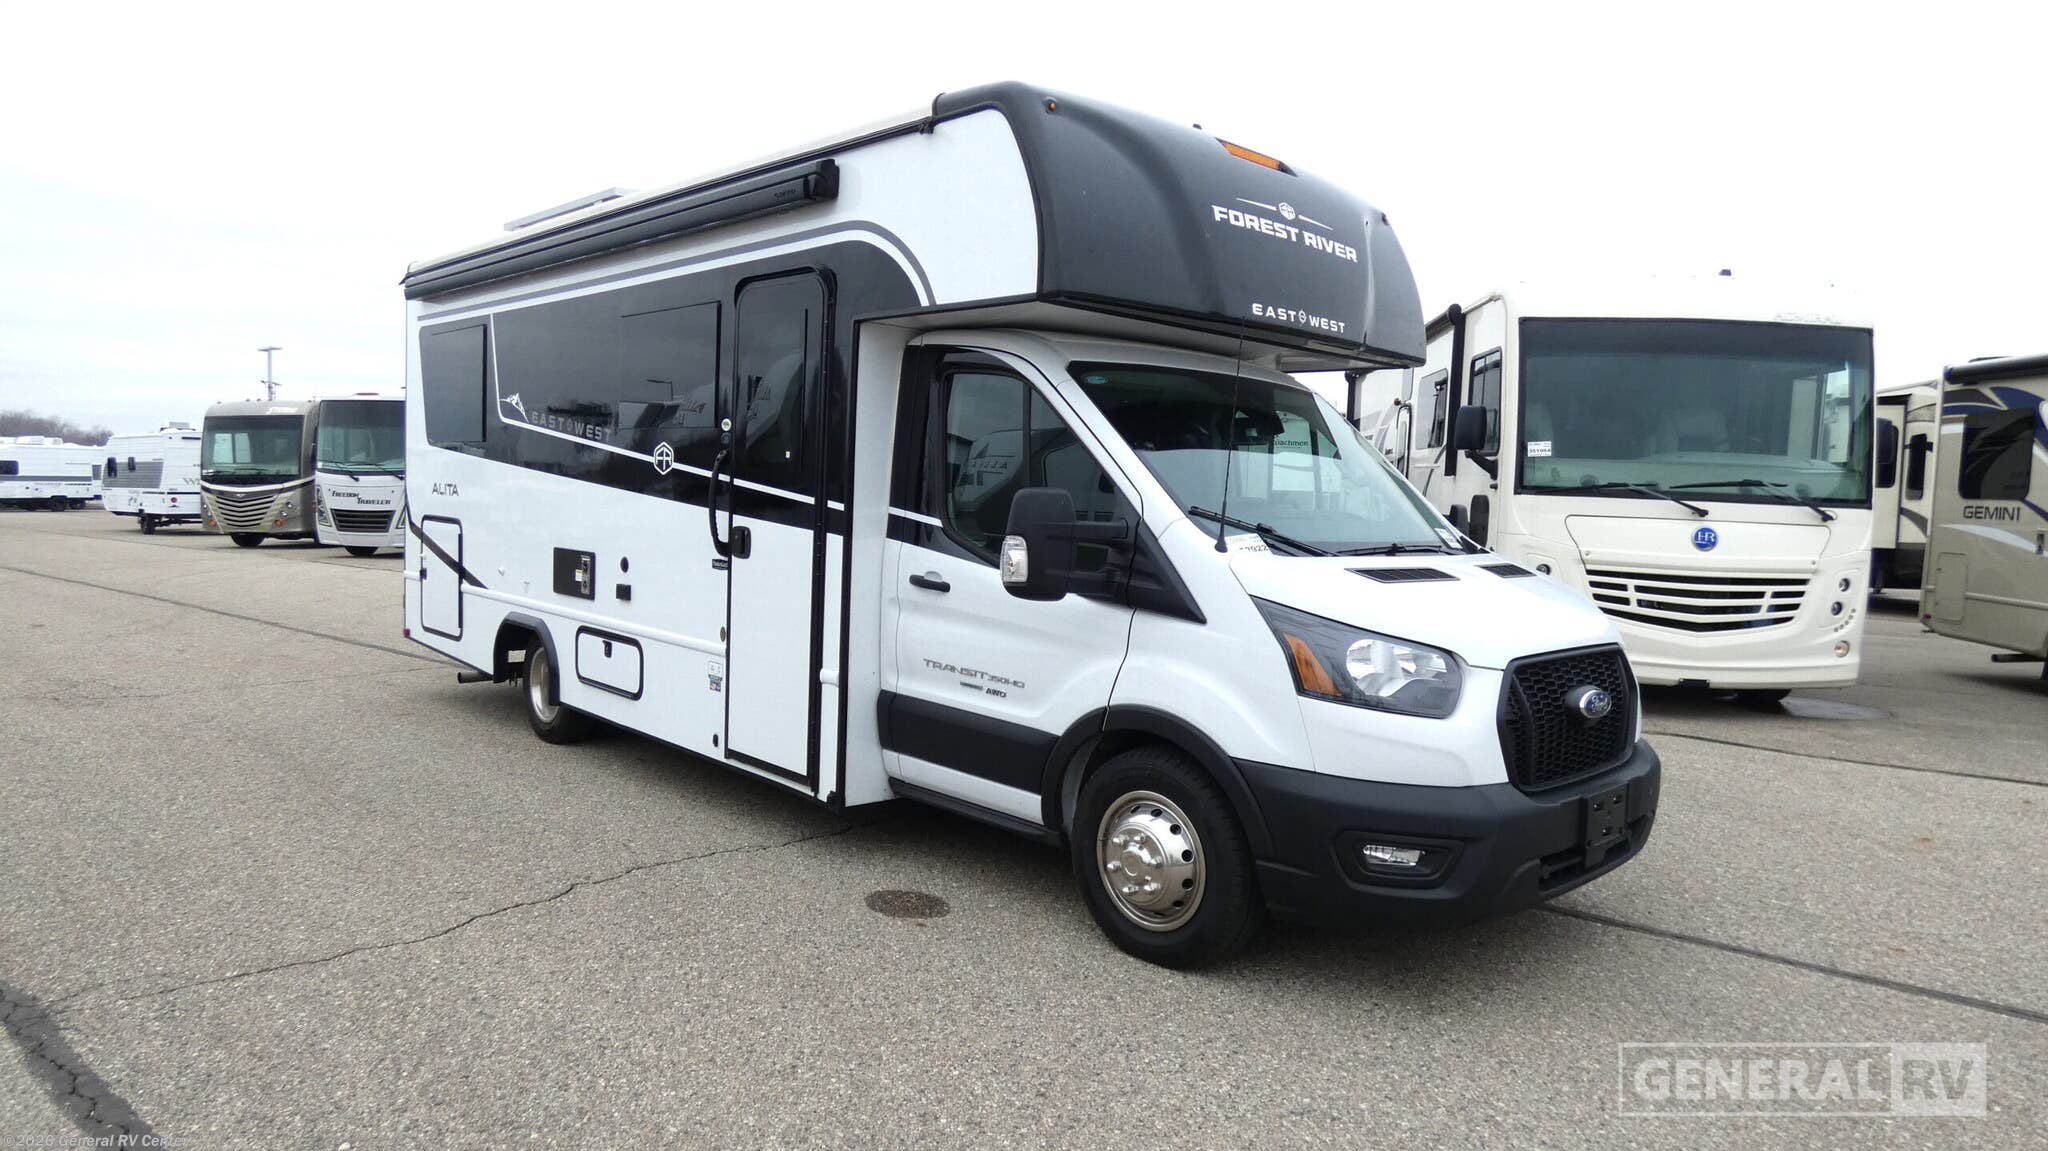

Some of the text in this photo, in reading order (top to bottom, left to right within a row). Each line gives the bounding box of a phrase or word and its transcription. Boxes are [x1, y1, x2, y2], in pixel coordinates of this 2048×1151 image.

[1211, 204, 1358, 263] FOREST RIVER
[1252, 303, 1345, 333] EAST WEST
[530, 411, 612, 441] EAST WEST
[331, 490, 360, 498] FREEDOM
[432, 482, 459, 496] ALITA
[356, 497, 391, 505] TRAVELER
[1963, 505, 2021, 521] GEMINI
[1697, 530, 1715, 542] HR
[923, 658, 988, 680] TRANSIT
[985, 687, 1007, 698] AWD
